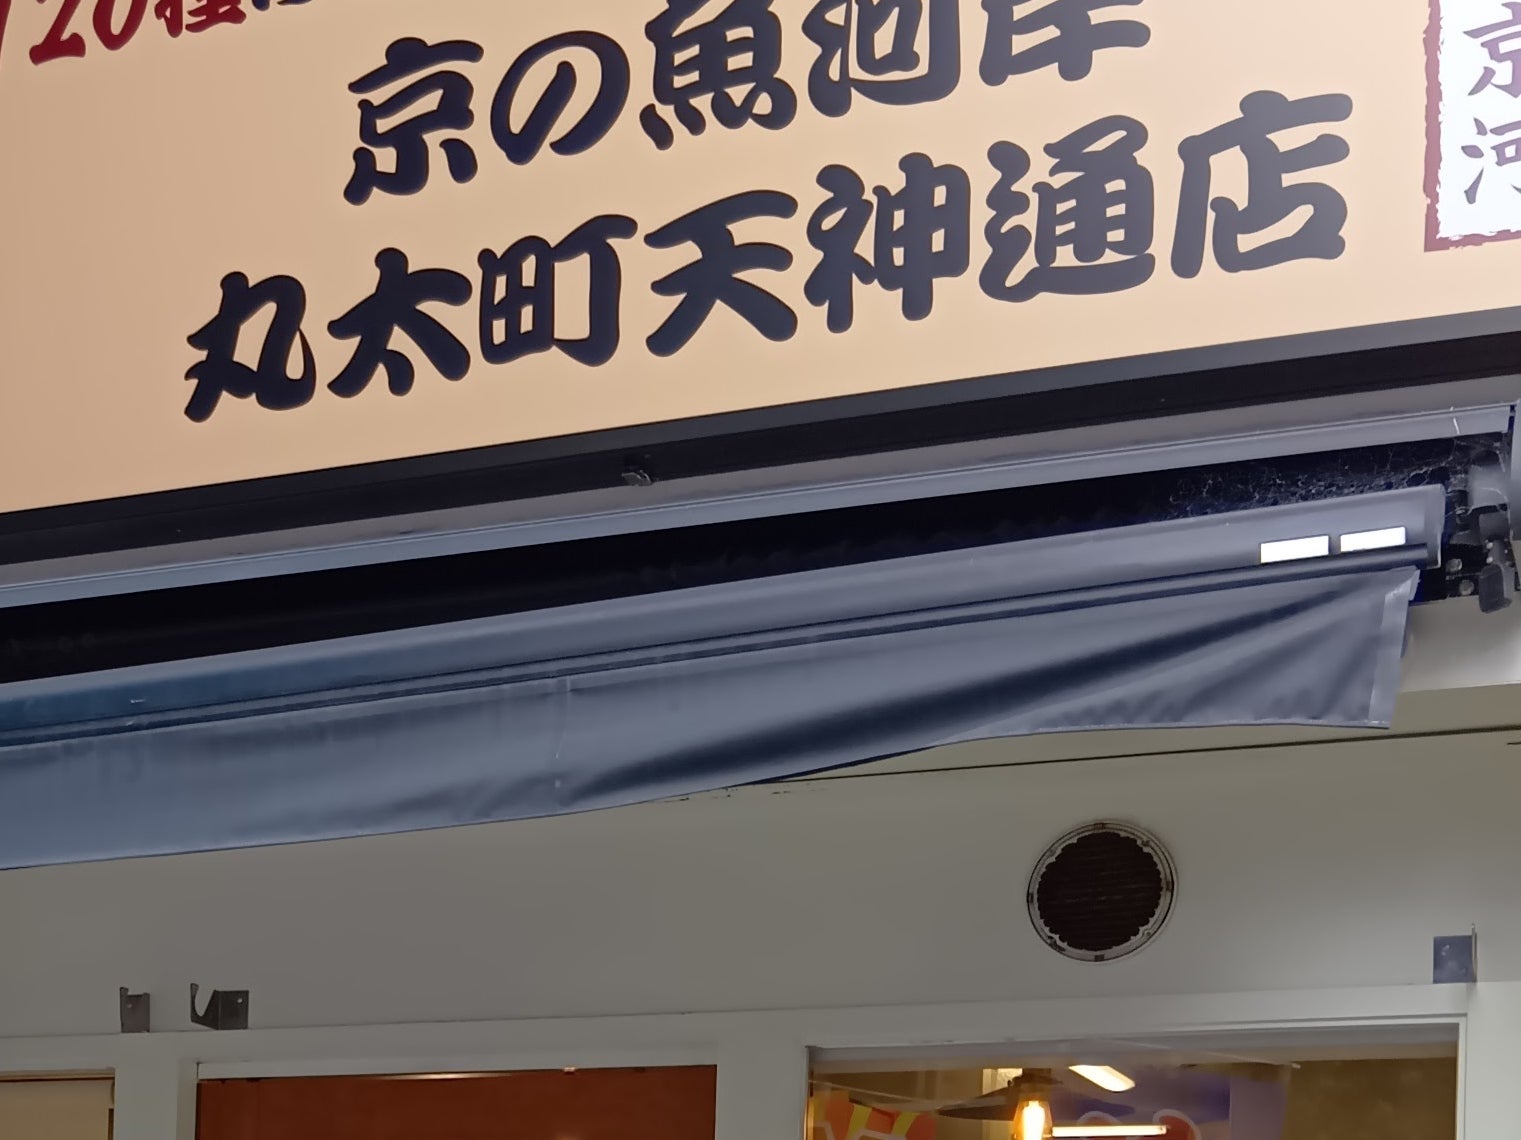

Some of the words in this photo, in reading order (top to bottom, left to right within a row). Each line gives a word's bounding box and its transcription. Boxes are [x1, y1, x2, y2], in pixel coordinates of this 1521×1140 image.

[183, 90, 1354, 423] 丸太町天神通店
